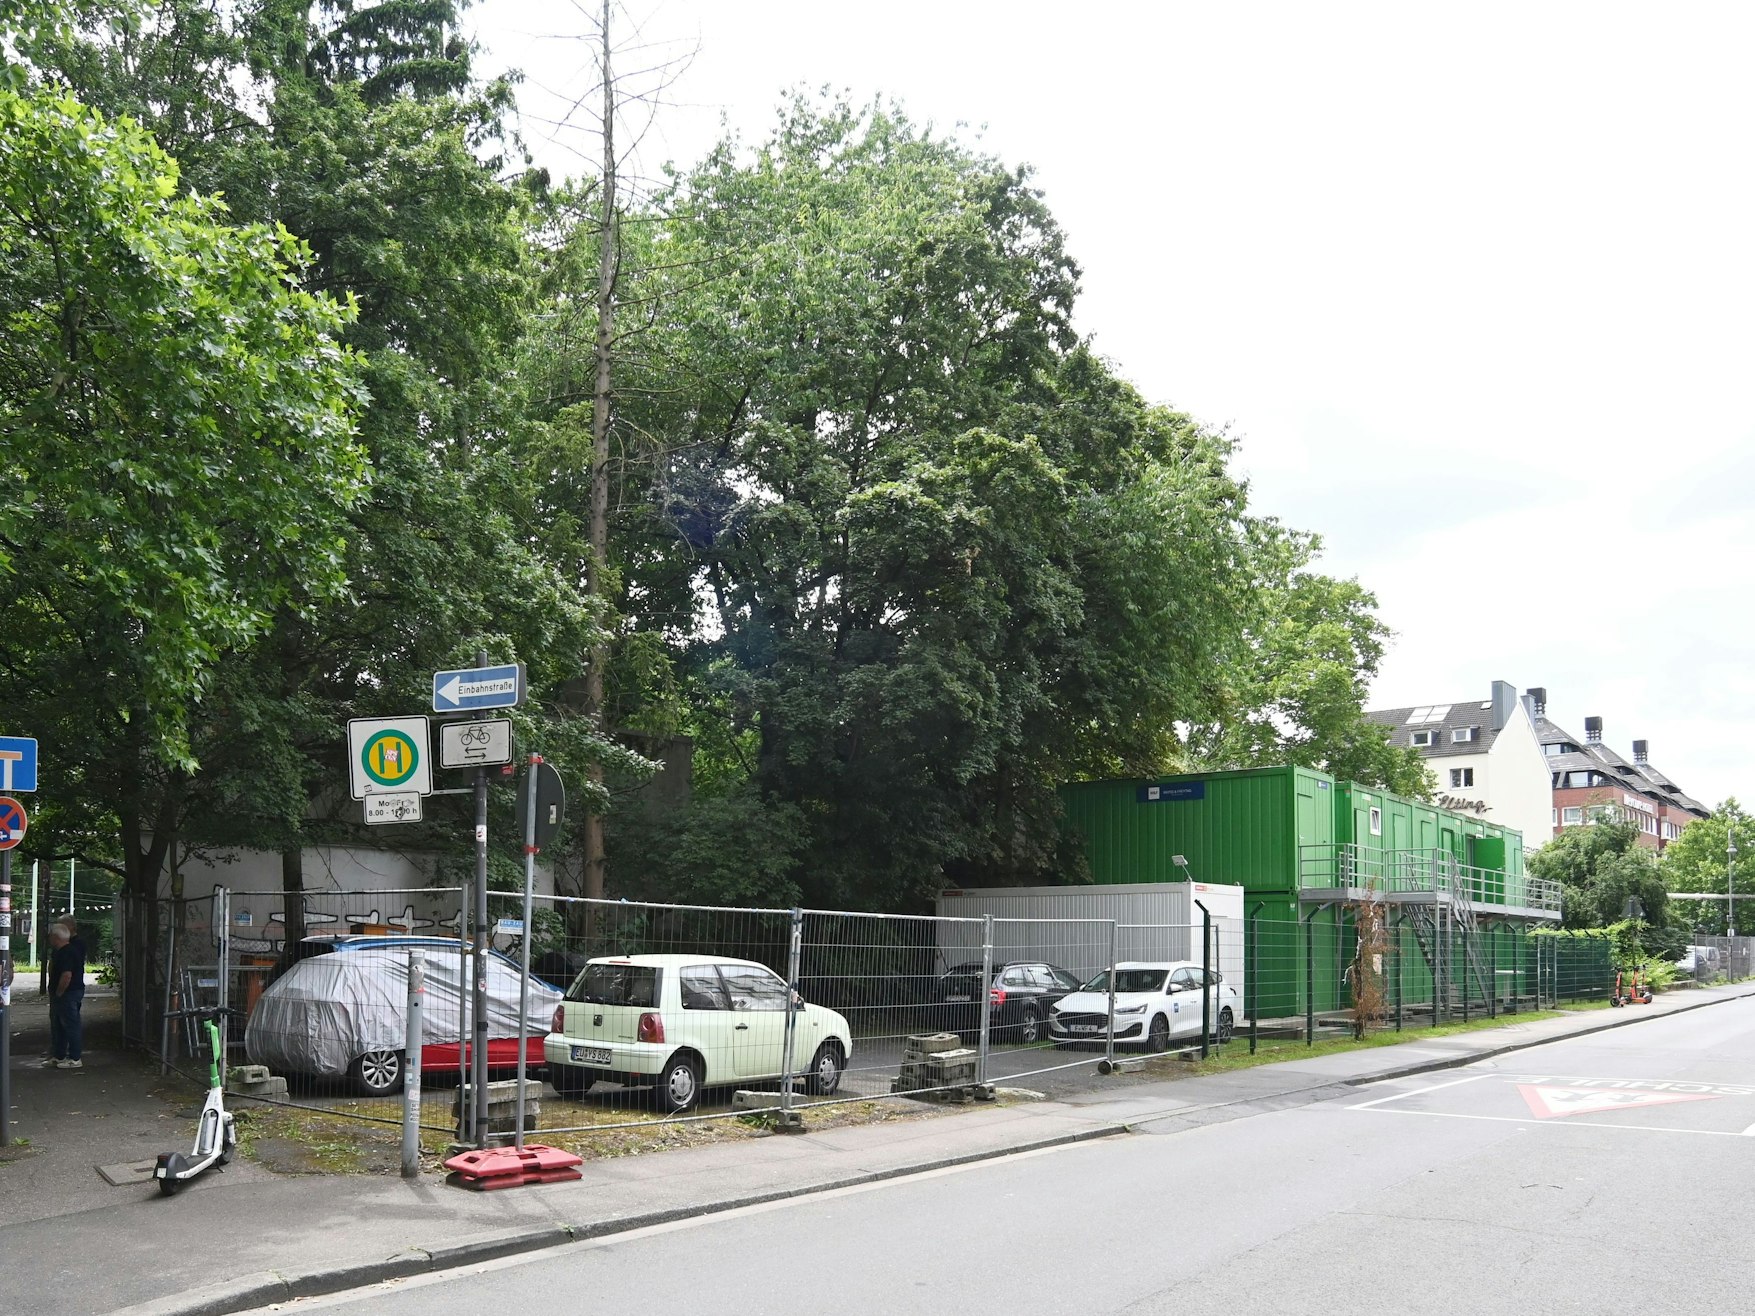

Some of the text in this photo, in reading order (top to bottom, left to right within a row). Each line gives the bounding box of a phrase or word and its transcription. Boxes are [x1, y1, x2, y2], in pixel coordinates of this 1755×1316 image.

[458, 681, 513, 695] Einbahnstraße
[368, 809, 384, 817] 8.00
[575, 1047, 585, 1057] EU
[1504, 1078, 1753, 1095] SCHULE
